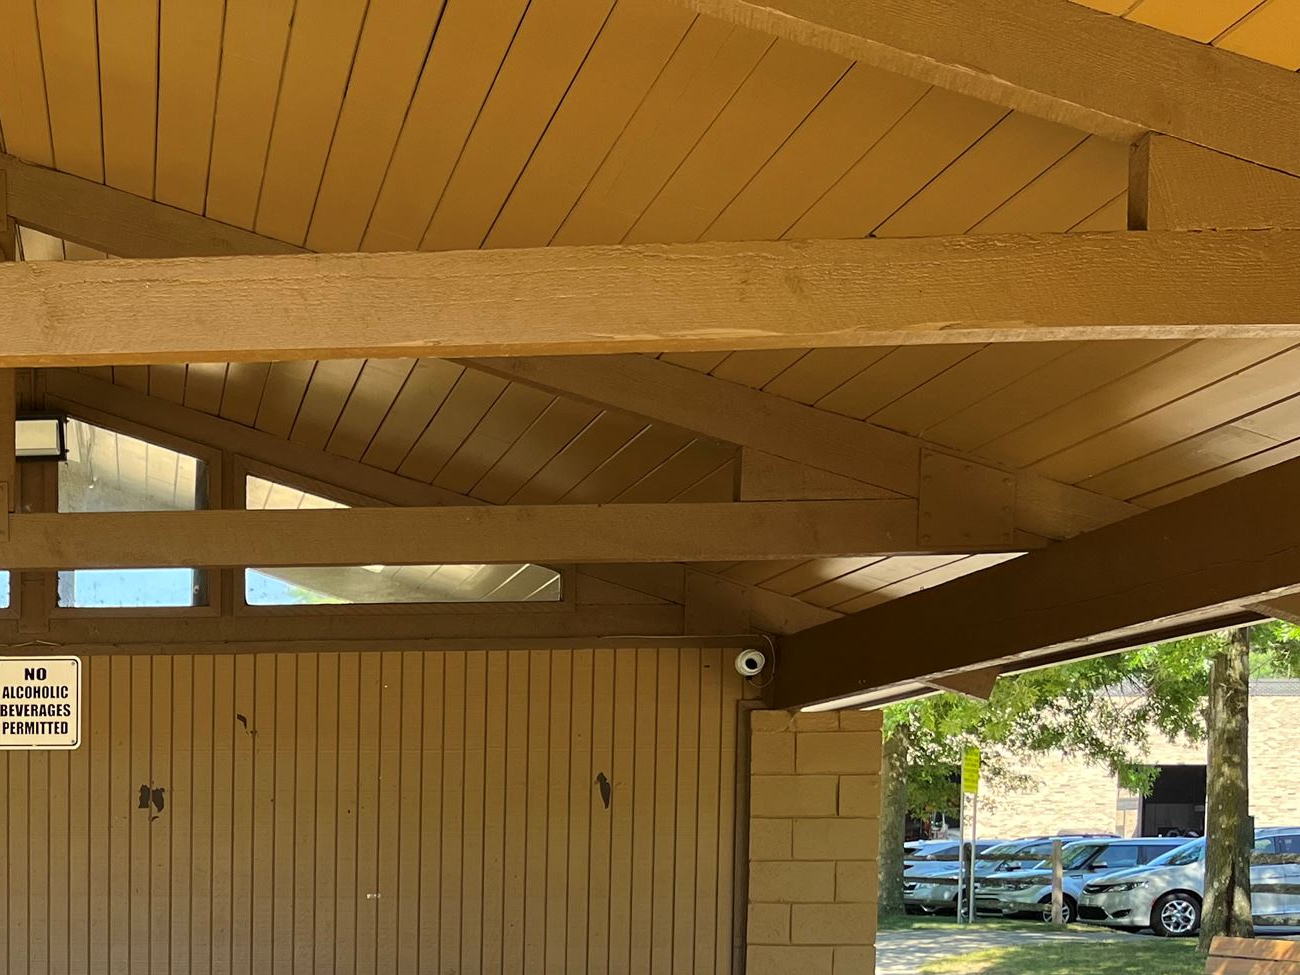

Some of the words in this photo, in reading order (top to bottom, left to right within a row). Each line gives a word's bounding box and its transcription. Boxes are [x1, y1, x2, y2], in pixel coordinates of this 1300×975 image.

[24, 667, 47, 681] NO
[2, 685, 69, 699] ALCOHOLIC
[0, 703, 71, 717] BEVERAGES
[2, 721, 69, 735] PERMITTED
